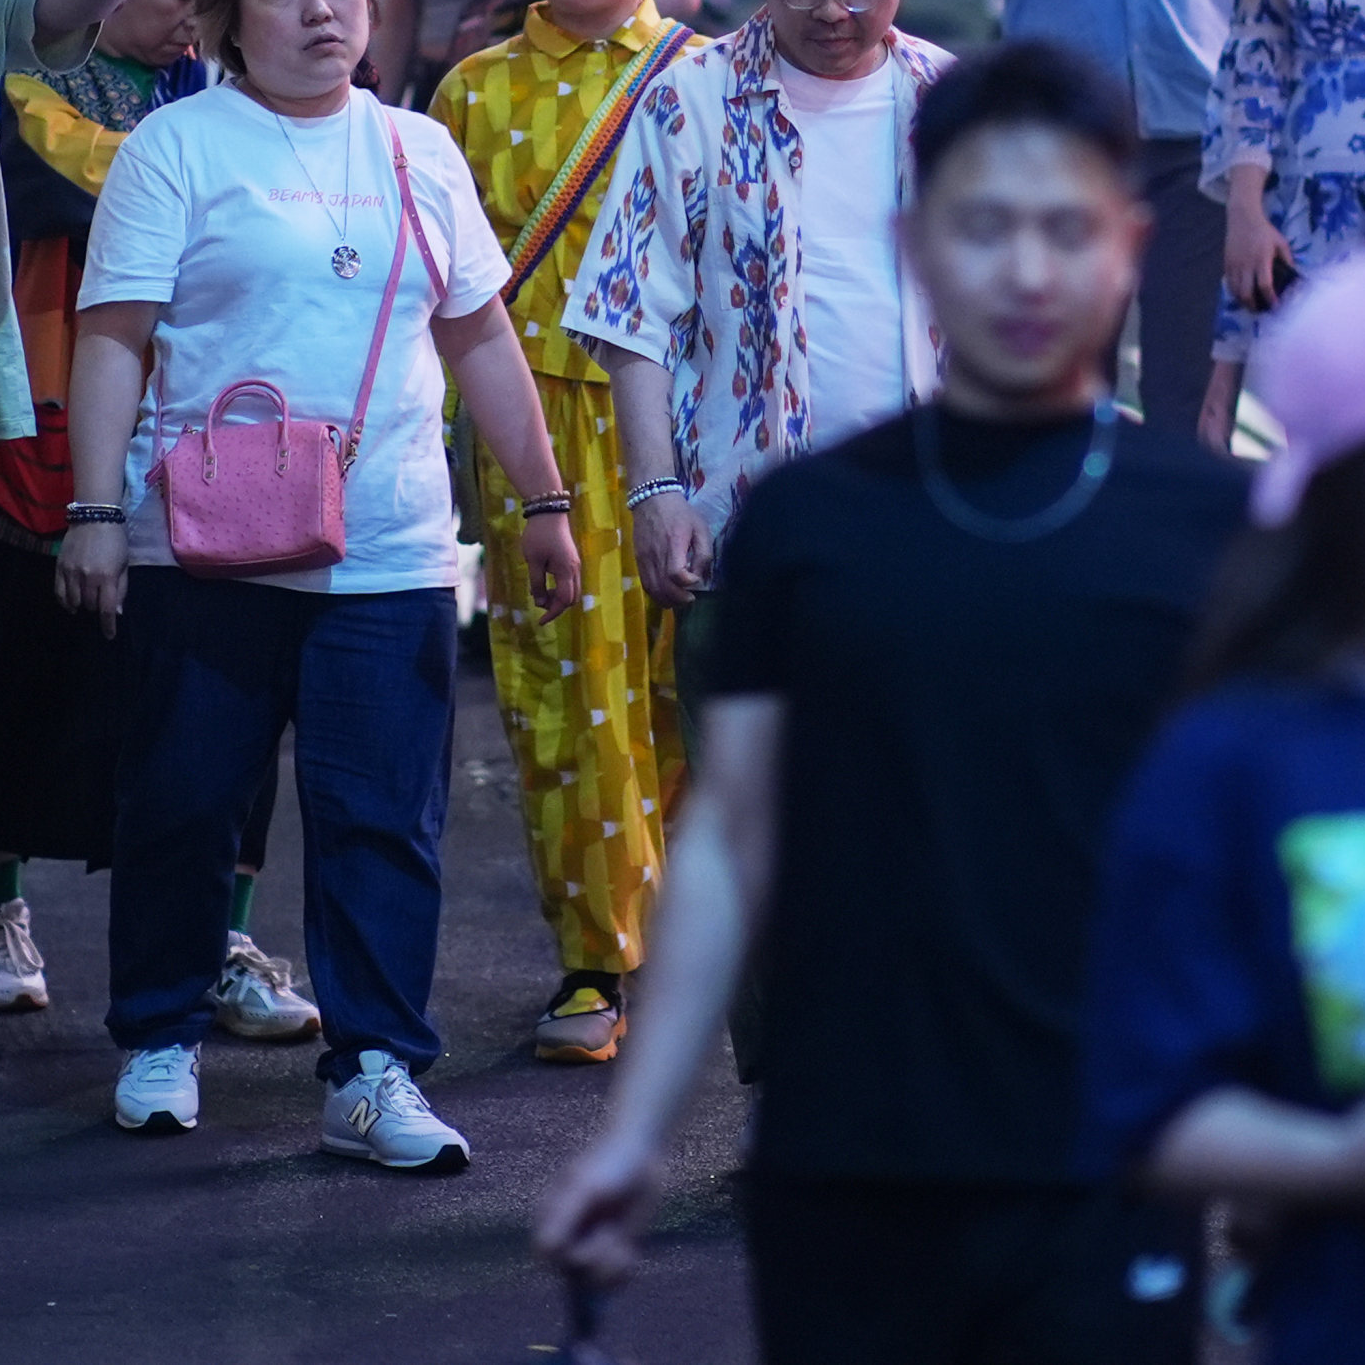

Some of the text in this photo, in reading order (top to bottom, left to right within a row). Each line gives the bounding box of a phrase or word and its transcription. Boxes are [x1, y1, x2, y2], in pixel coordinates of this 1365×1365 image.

[268, 188, 384, 208] BEAMS JAPAN
[348, 1095, 382, 1137] N
